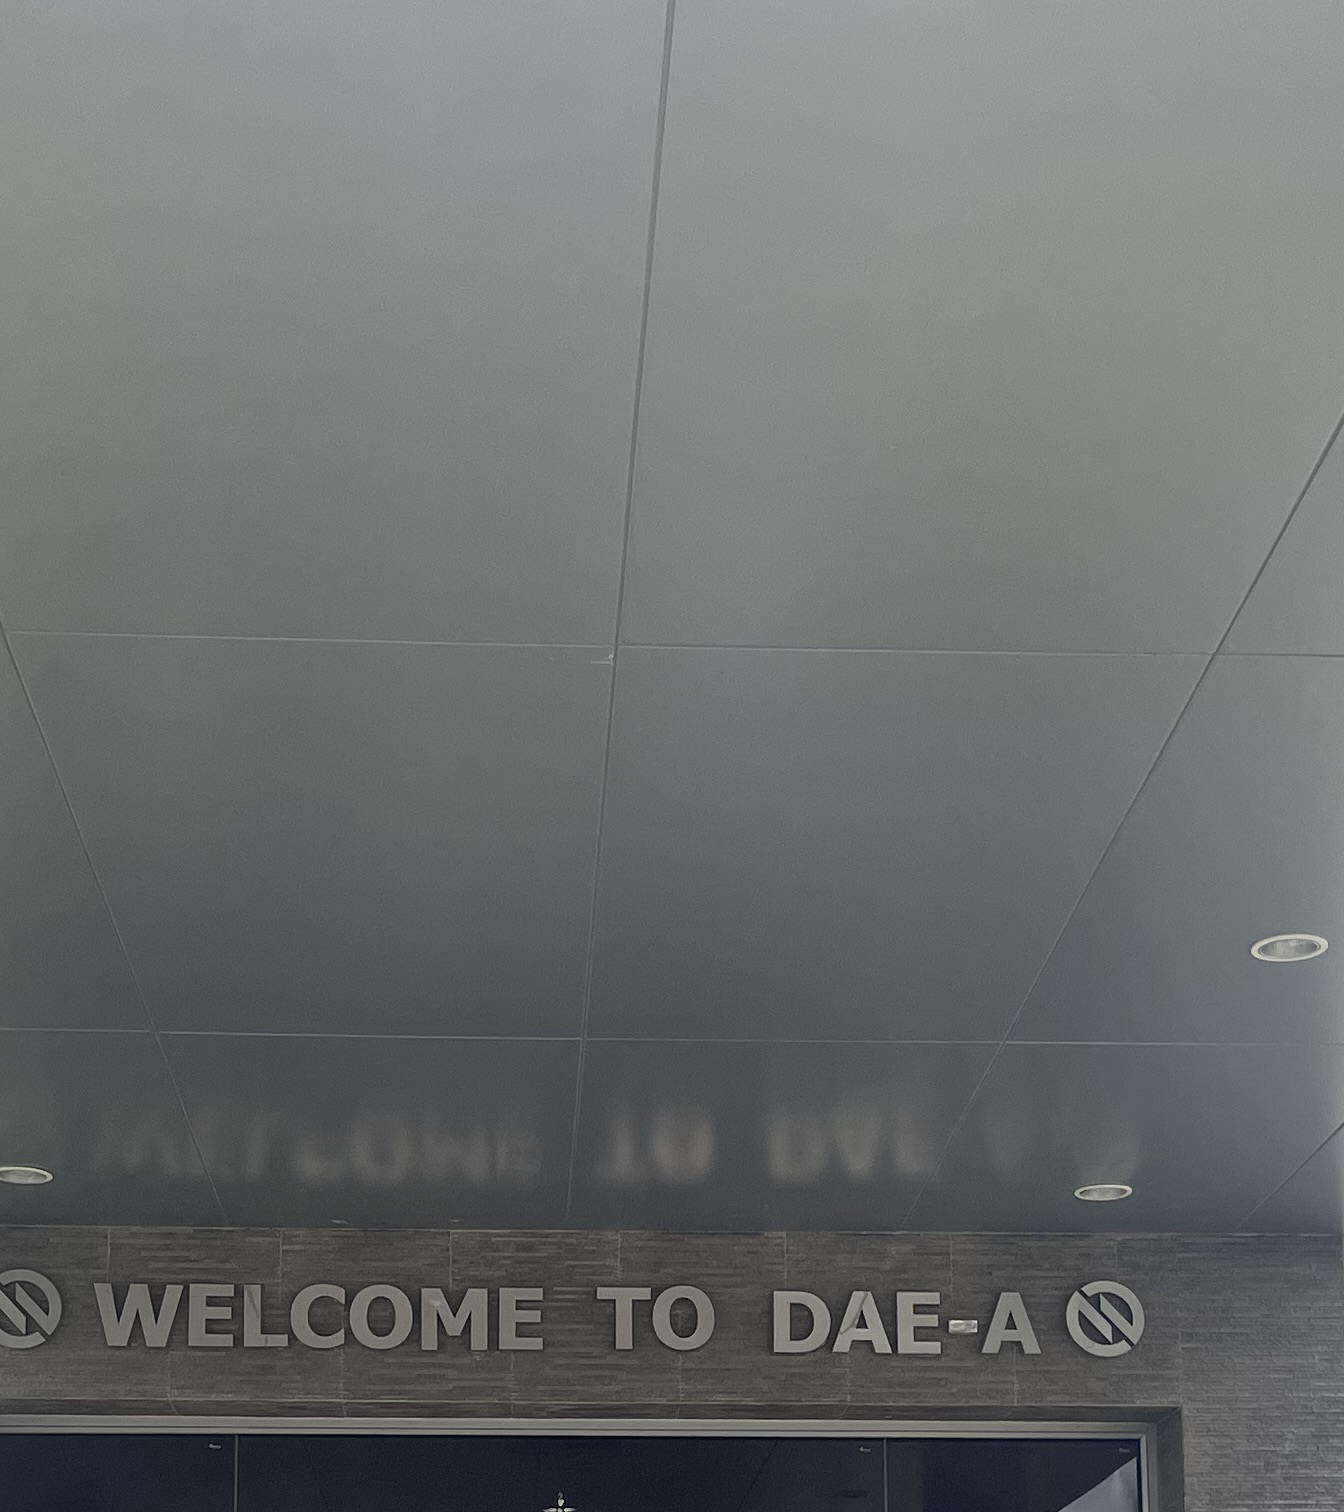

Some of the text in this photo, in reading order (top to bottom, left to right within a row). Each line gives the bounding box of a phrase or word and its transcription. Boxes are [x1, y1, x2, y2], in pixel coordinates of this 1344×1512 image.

[93, 1283, 1042, 1355] WELCOME TO DAE-A
